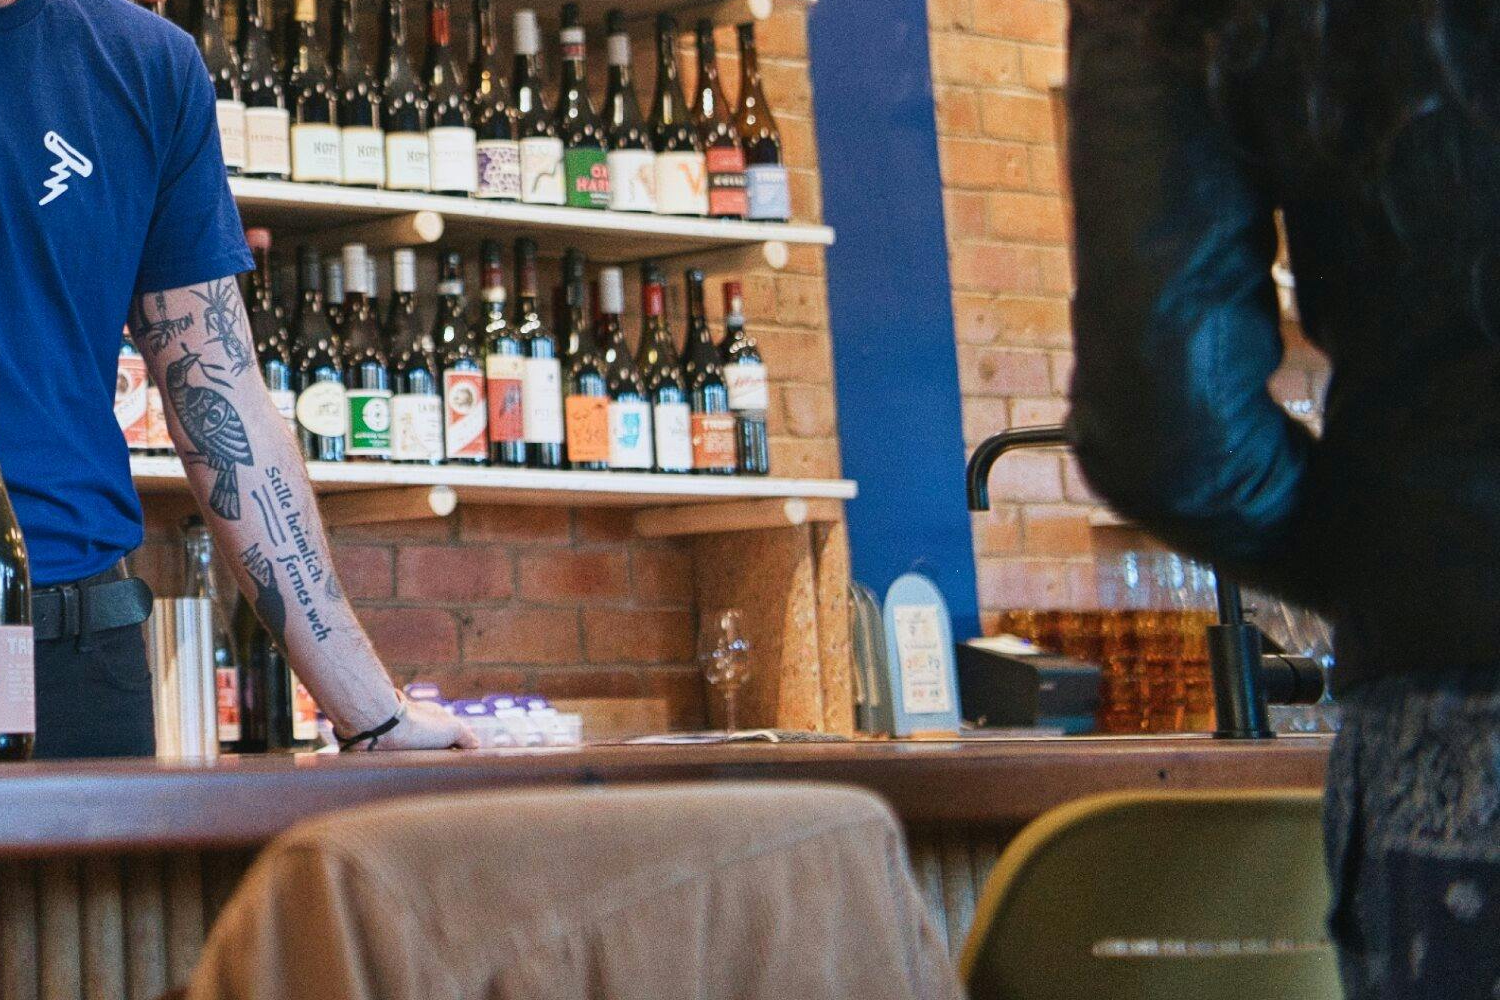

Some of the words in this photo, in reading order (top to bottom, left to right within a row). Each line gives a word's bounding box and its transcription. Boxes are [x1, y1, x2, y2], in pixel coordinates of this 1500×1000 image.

[265, 466, 291, 510] Stille
[286, 511, 323, 584] heimlich
[276, 553, 312, 605] fernes
[306, 607, 333, 643] weh
